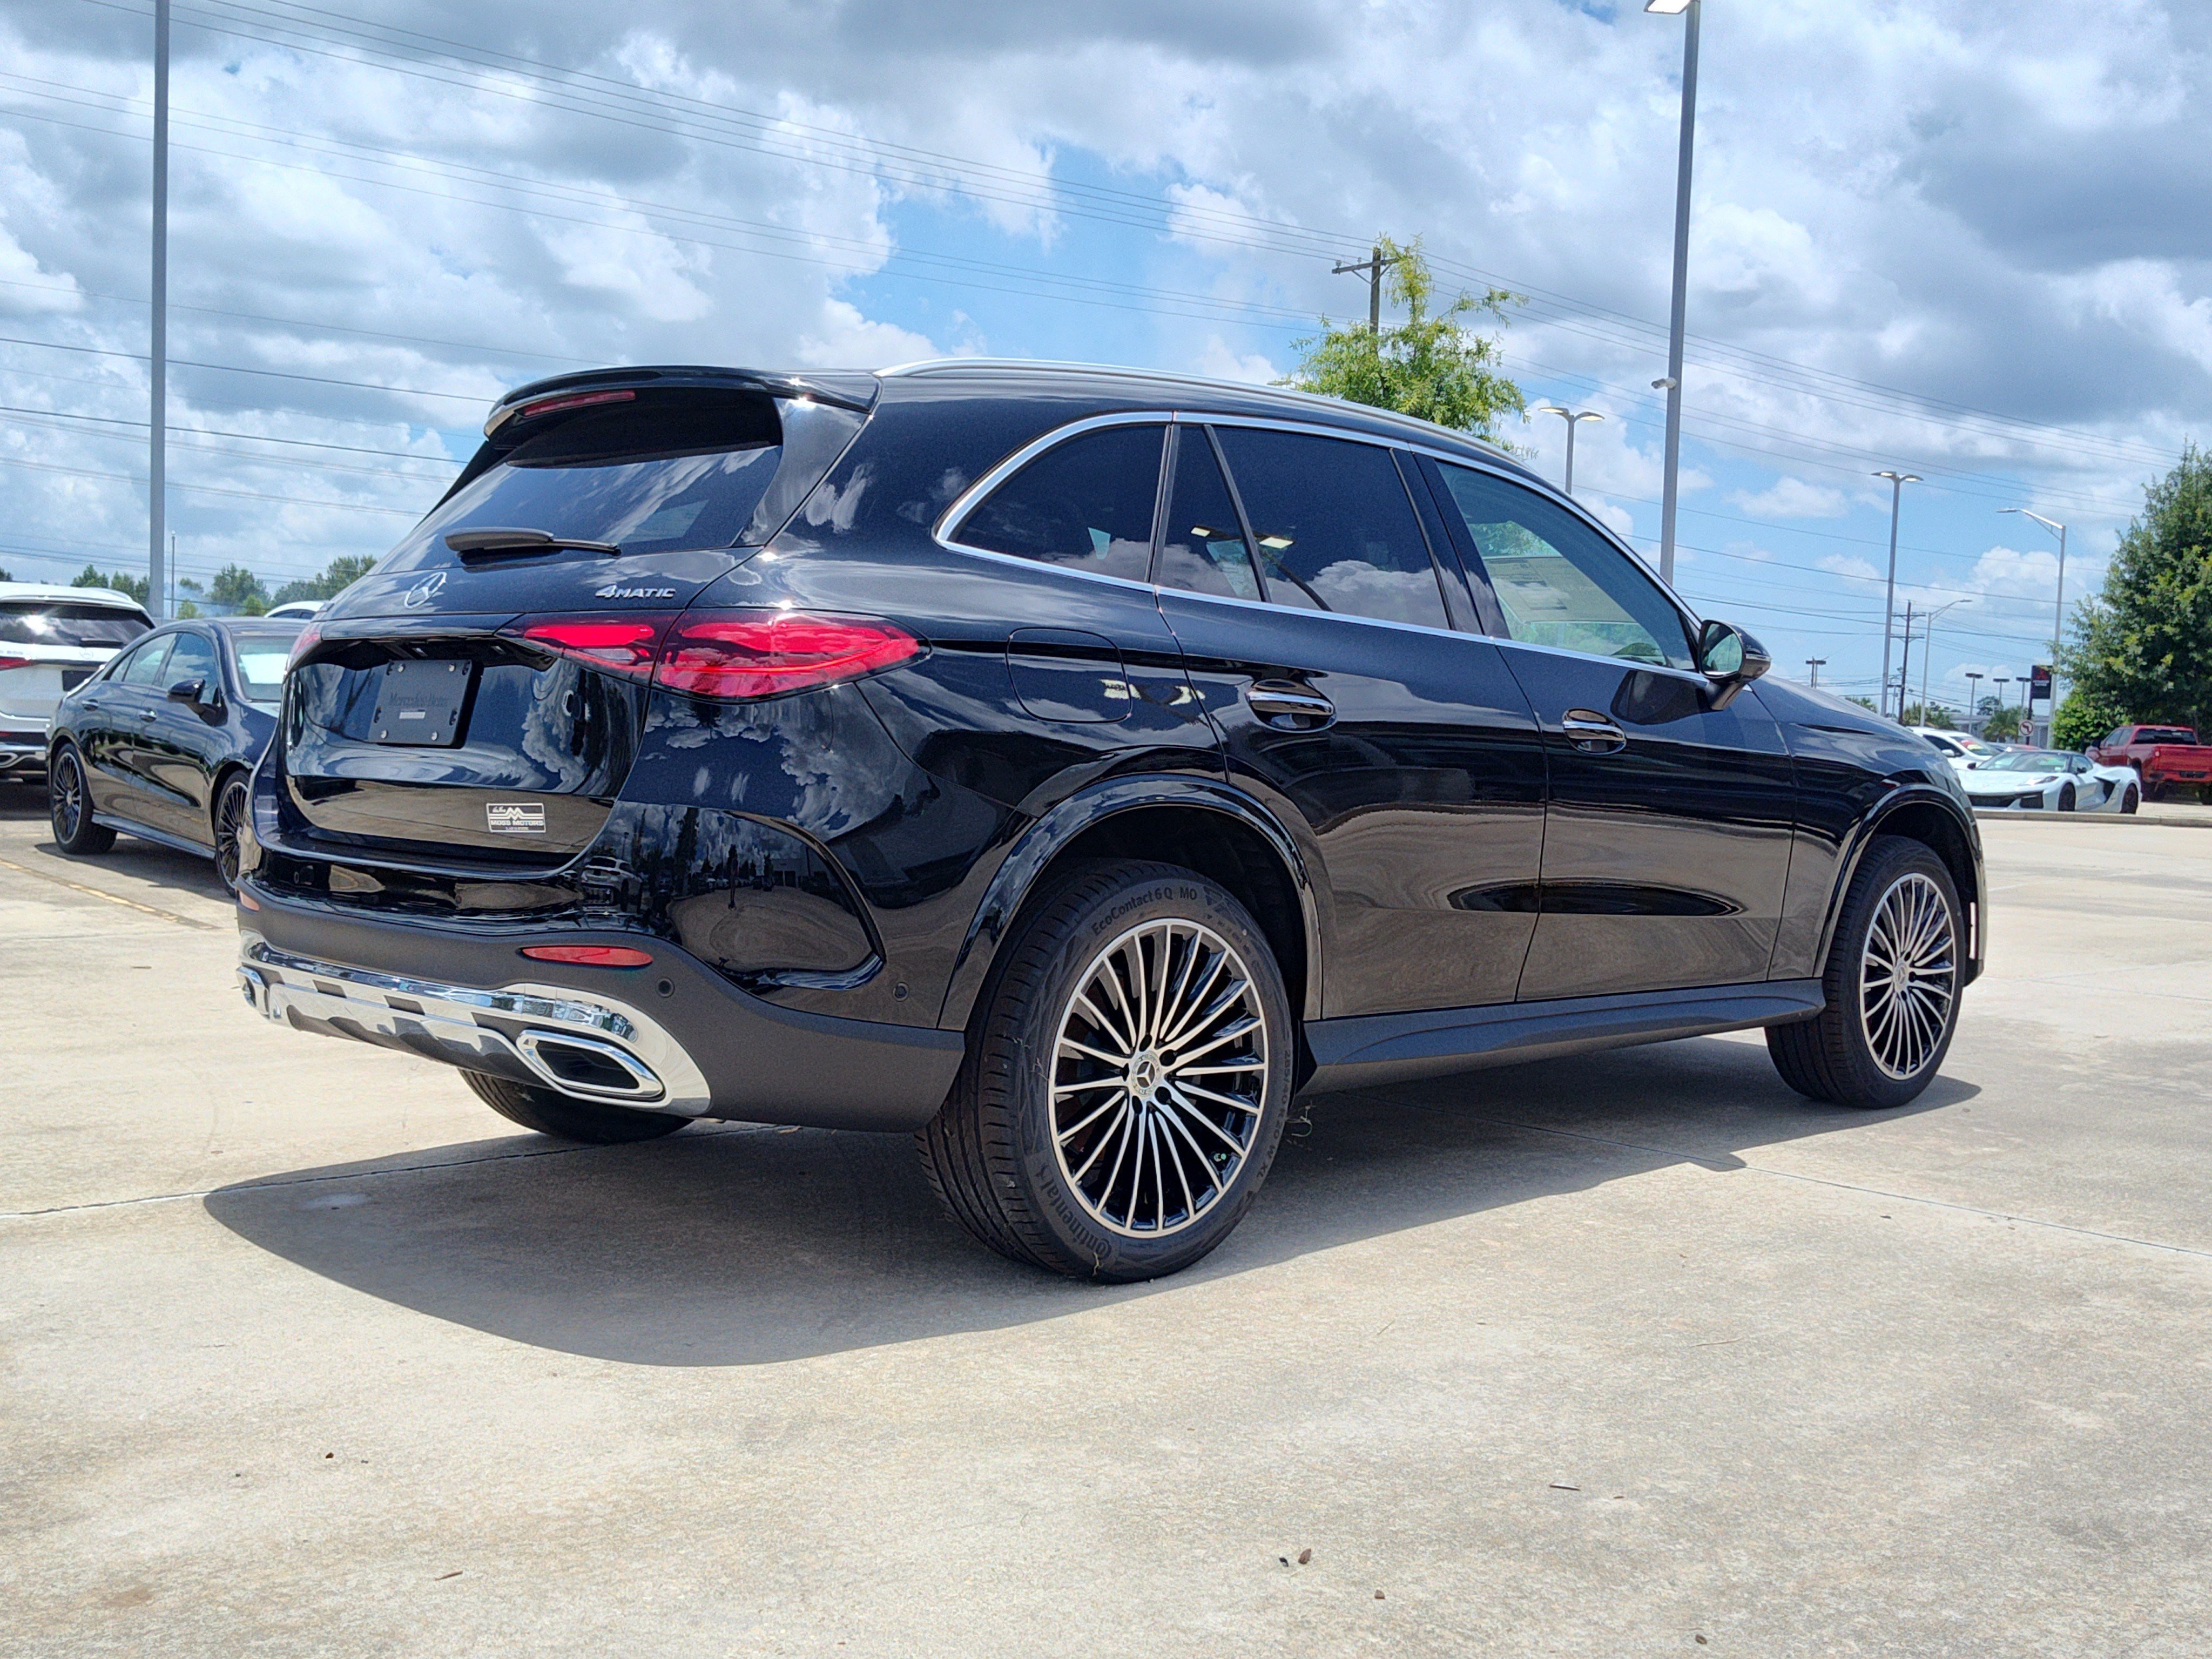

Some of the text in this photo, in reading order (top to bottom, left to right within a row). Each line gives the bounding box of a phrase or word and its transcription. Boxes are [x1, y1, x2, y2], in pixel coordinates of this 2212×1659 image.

[595, 584, 676, 598] 4MATIC
[1180, 887, 1197, 900] MO
[1041, 1178, 1112, 1260] Continental
